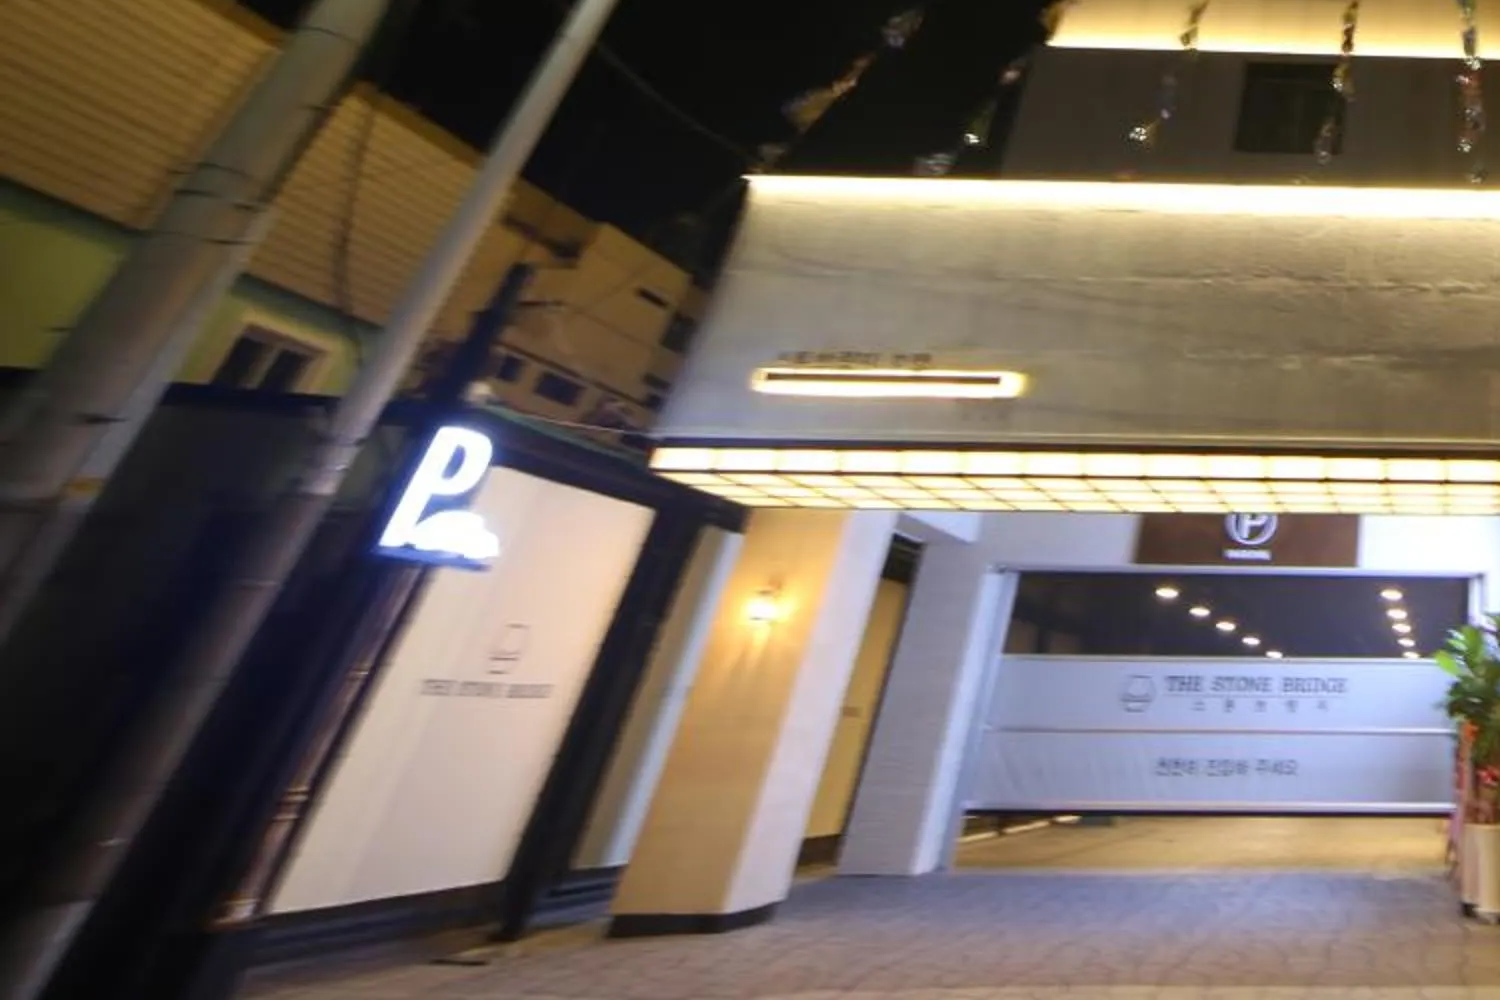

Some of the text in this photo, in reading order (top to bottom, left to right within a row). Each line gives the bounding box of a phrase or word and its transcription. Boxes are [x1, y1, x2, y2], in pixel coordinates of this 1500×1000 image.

[378, 425, 494, 547] P
[1165, 675, 1349, 695] THE STONE BRIDGE
